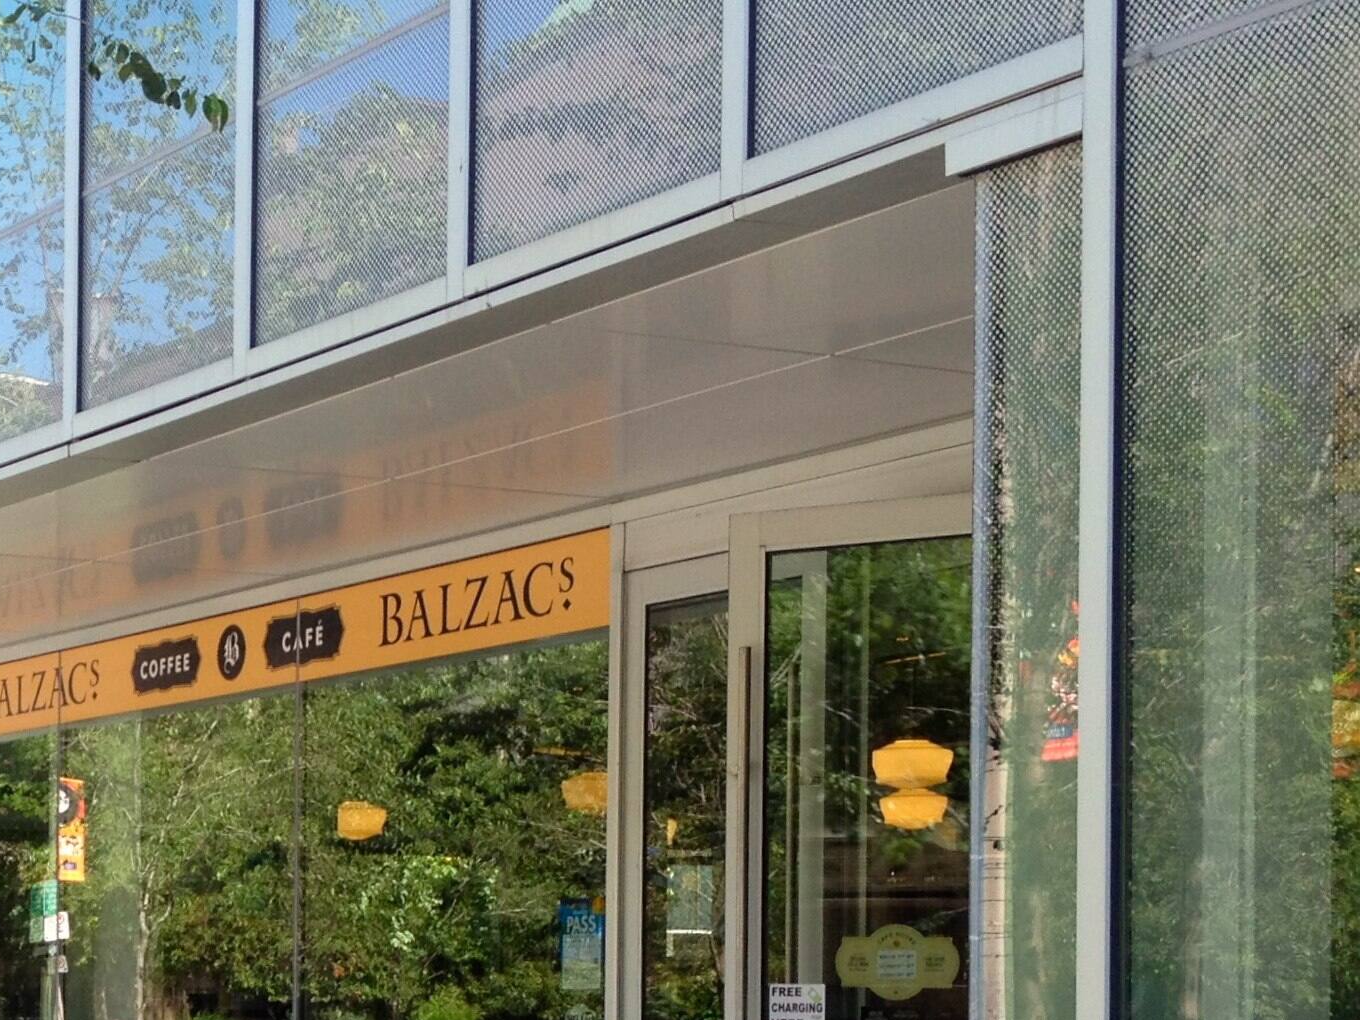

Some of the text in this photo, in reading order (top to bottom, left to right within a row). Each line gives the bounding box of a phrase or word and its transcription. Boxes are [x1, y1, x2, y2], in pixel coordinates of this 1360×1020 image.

[140, 652, 191, 681] COFFEE
[281, 620, 324, 653] CAFÉ
[566, 915, 597, 933] PASS
[771, 987, 801, 997] FREE
[771, 1002, 823, 1013] CHARGING
